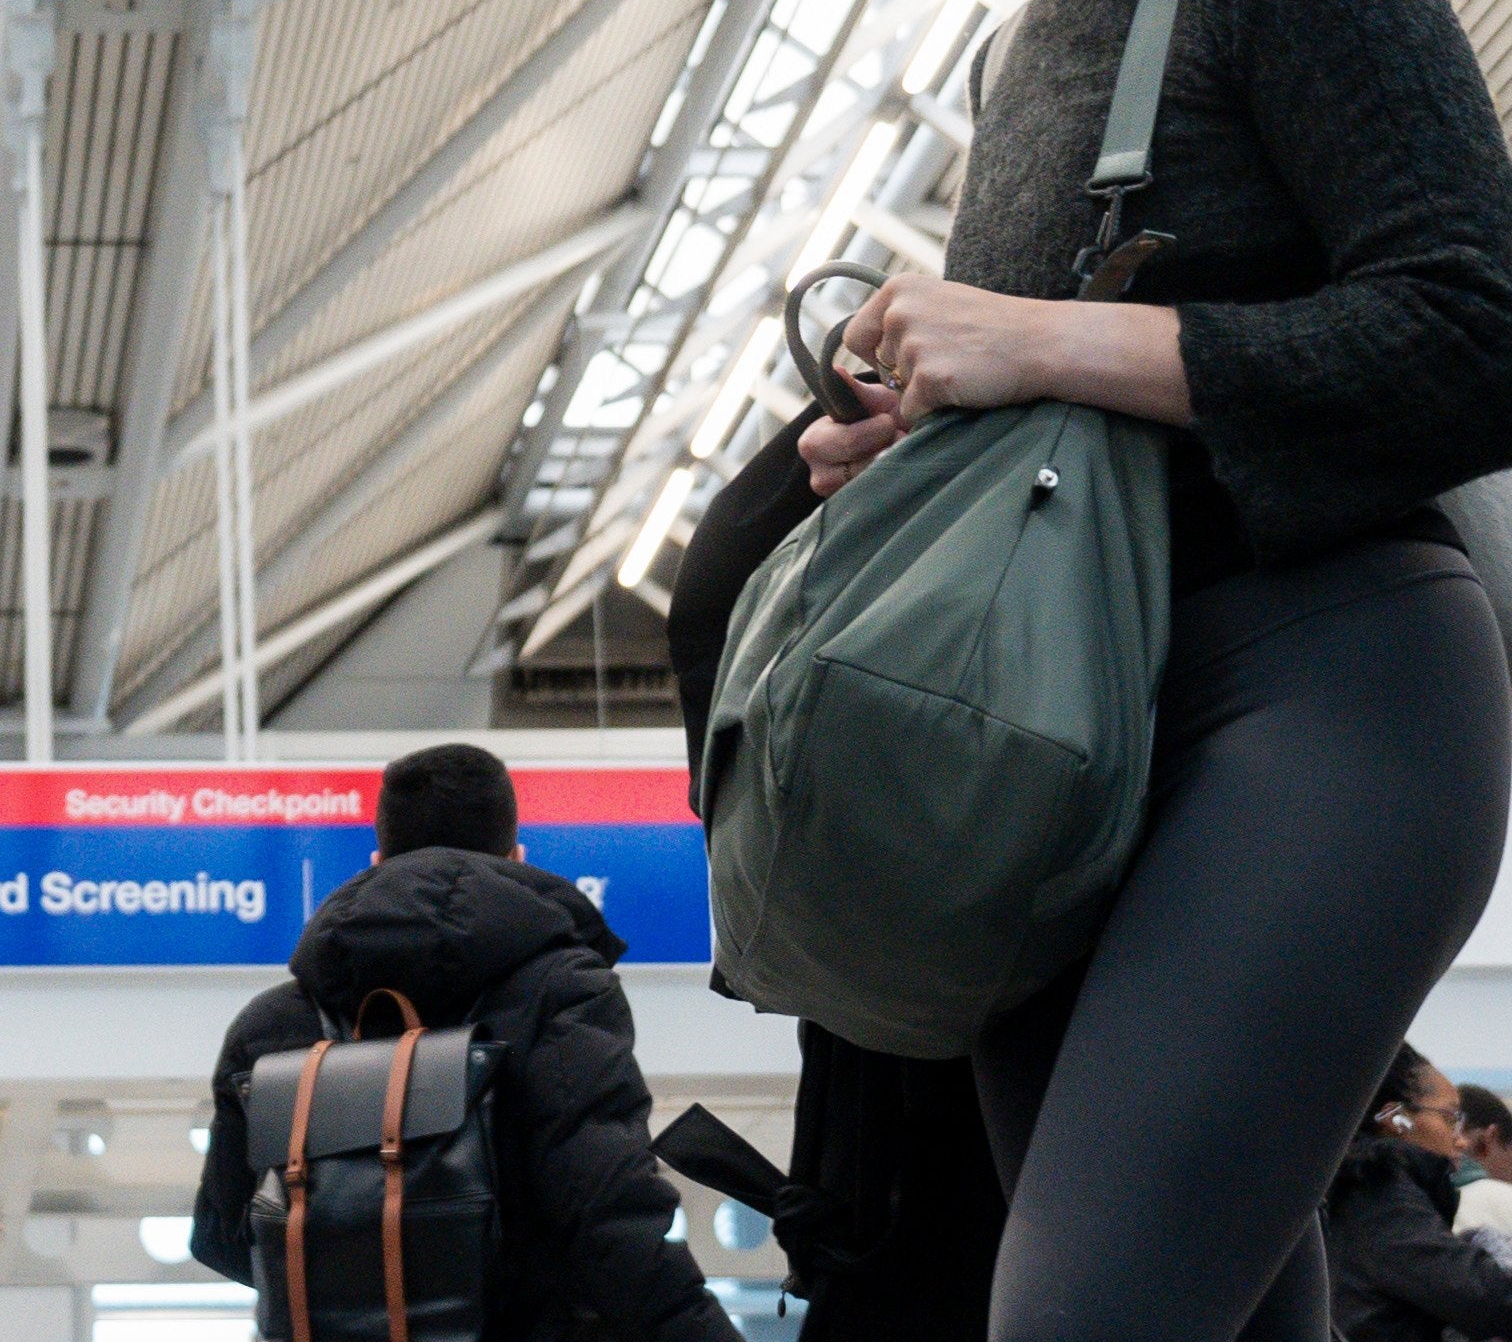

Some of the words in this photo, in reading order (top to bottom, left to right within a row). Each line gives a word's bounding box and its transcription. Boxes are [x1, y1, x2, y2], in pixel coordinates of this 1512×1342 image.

[65, 788, 185, 822] Security
[191, 787, 361, 822] Checkpoint
[40, 870, 266, 924] Screening
